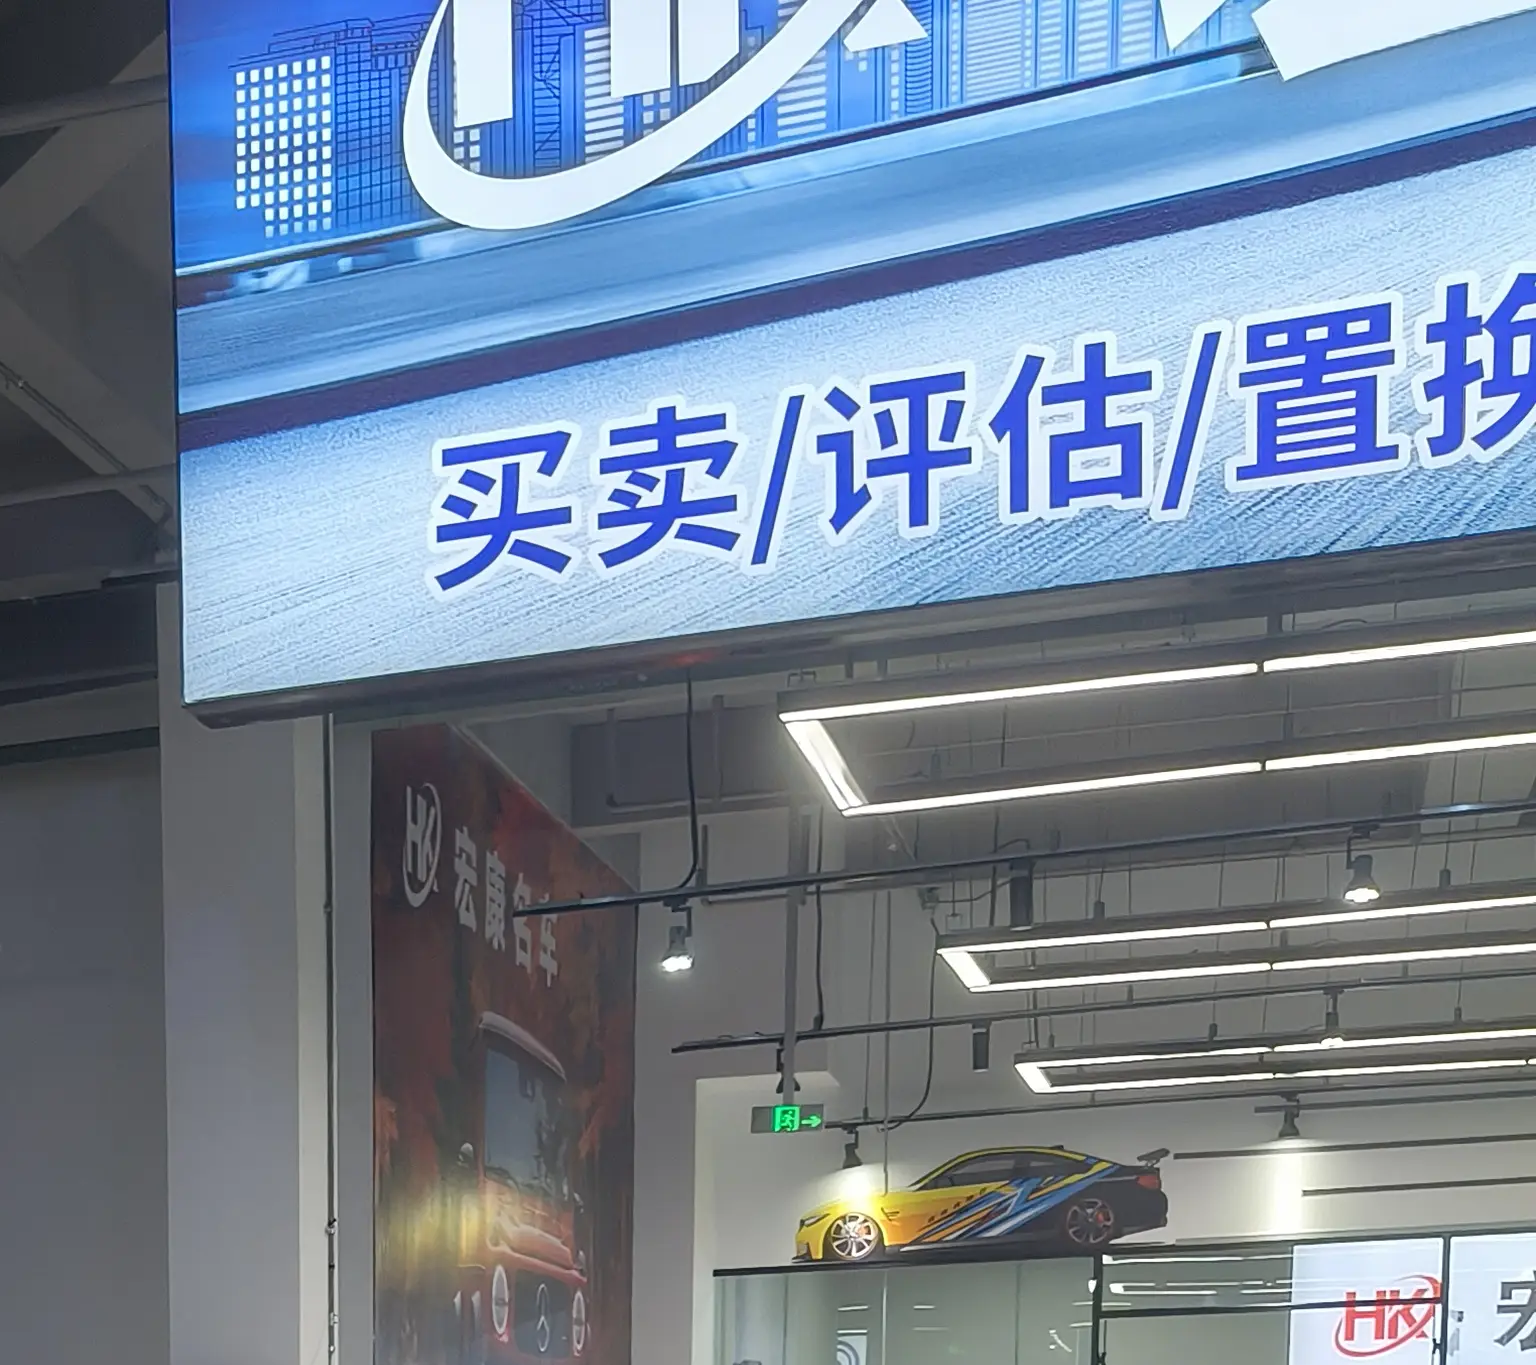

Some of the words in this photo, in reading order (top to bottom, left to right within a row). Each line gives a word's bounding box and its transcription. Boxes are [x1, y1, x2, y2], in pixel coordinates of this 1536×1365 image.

[435, 271, 1536, 591] 买卖/评估/置换
